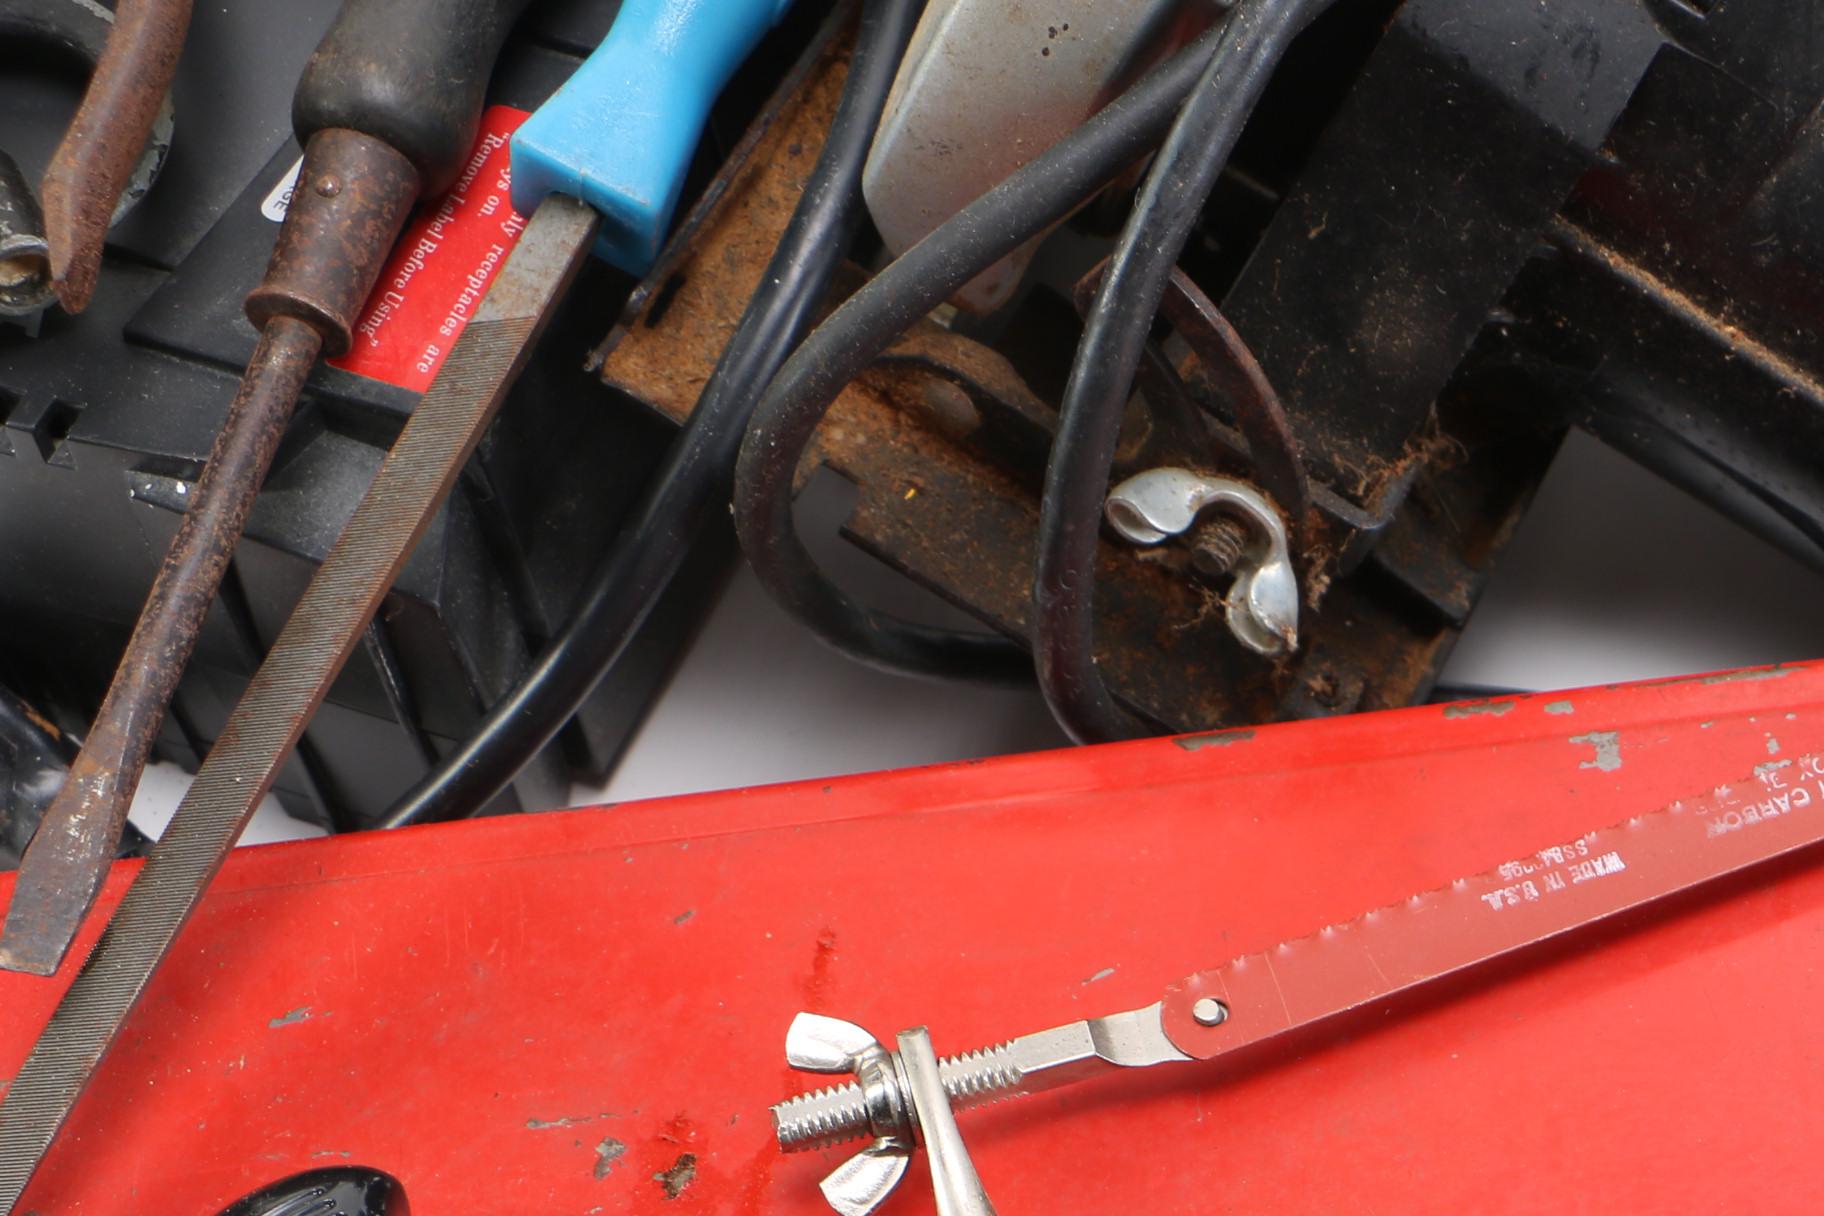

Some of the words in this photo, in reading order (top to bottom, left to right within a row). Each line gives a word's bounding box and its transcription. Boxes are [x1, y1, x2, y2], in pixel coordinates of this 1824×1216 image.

[424, 191, 464, 239] Label
[477, 193, 501, 221] on.
[391, 235, 436, 292] Before
[436, 242, 506, 339] receptacles
[414, 343, 441, 375] are
[1541, 869, 1566, 893] IN
[1567, 849, 1626, 884] MADE
